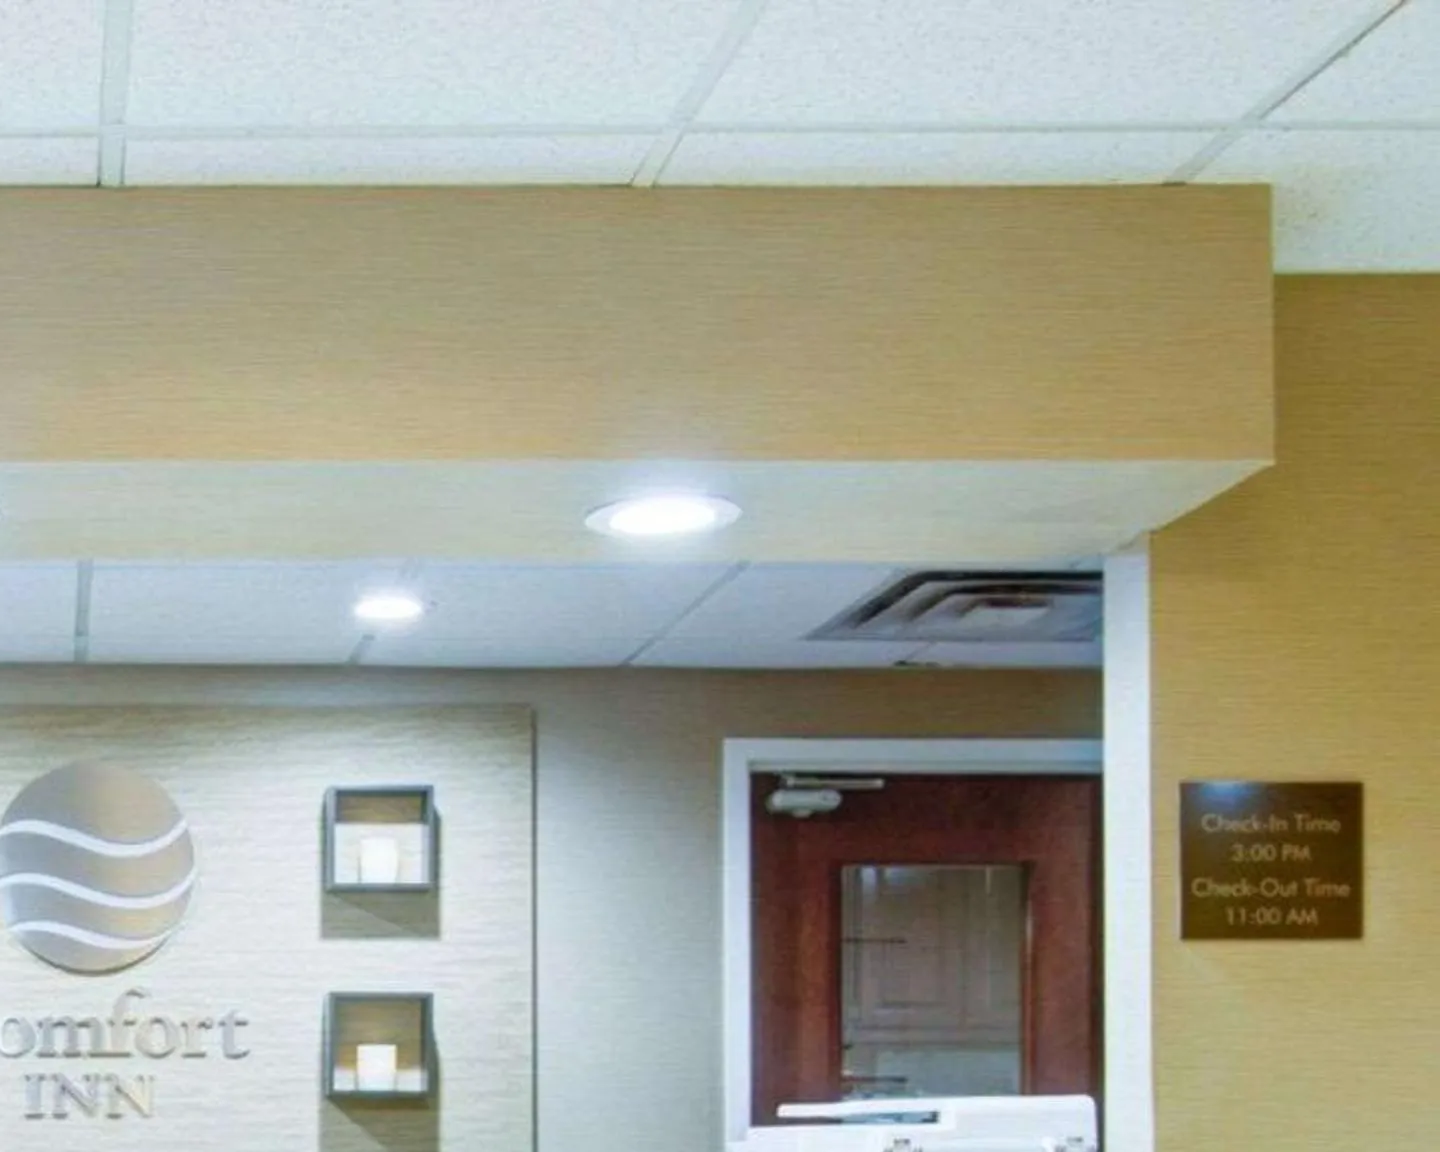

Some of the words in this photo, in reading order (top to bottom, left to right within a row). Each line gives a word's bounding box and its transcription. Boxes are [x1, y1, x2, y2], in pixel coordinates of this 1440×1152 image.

[1200, 813, 1290, 834] Check-In
[1294, 813, 1342, 834] Time
[1231, 843, 1277, 862] 3:00
[1281, 844, 1312, 862] PM
[1190, 876, 1299, 898] Check-Out
[1305, 876, 1352, 898] Time
[1224, 906, 1282, 926] 11:00
[1285, 907, 1319, 926] AM
[23, 1073, 157, 1121] INN
